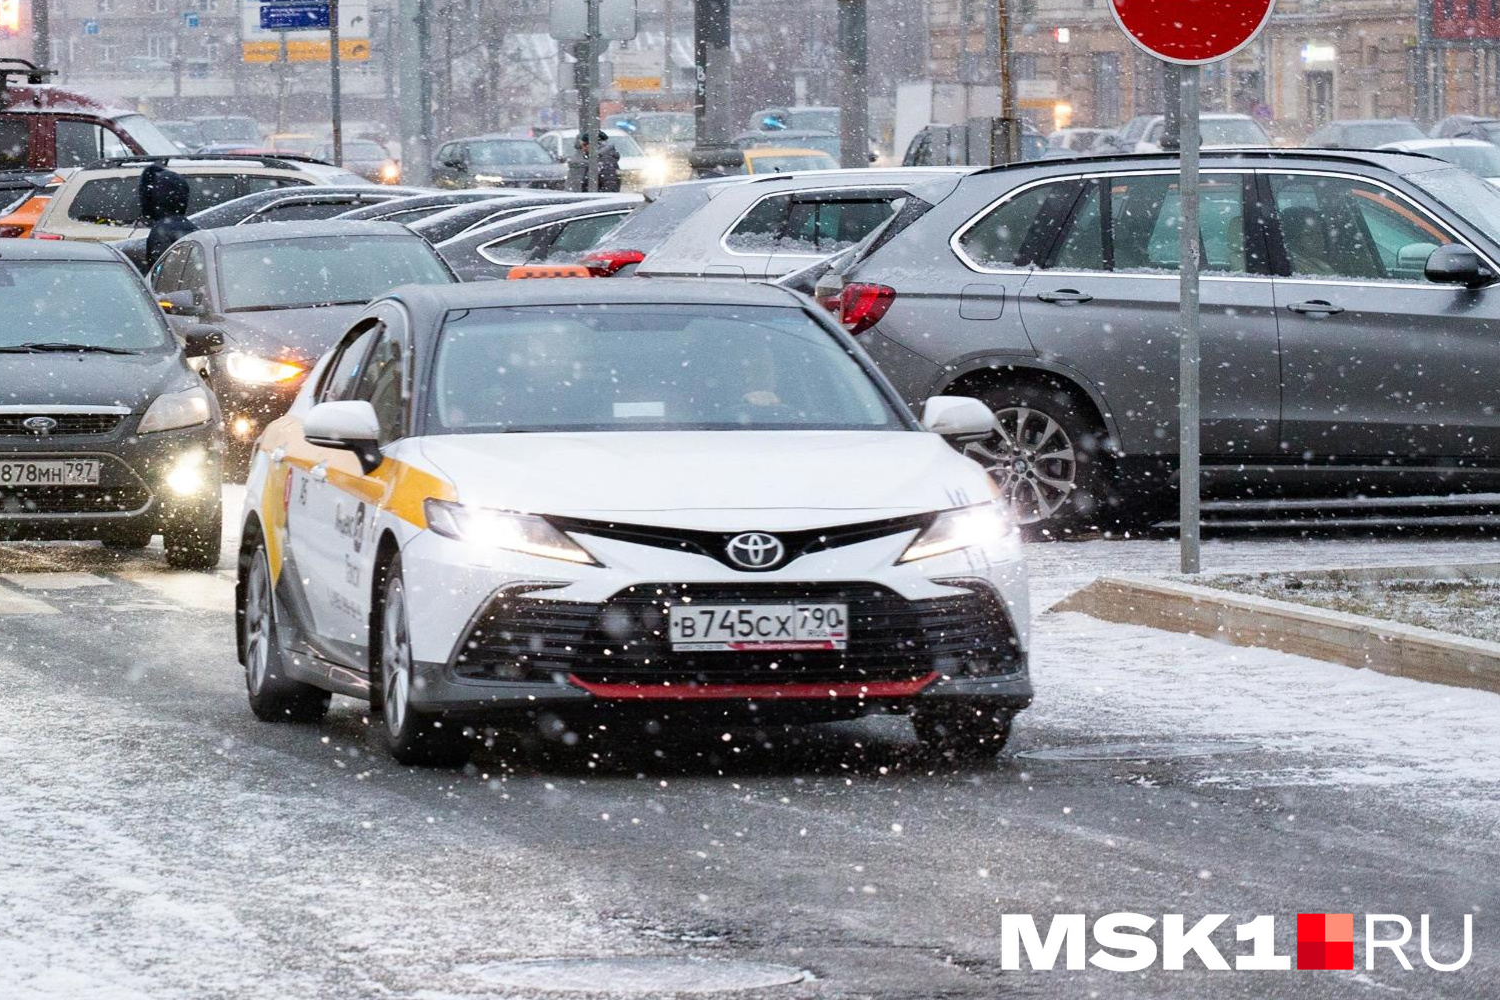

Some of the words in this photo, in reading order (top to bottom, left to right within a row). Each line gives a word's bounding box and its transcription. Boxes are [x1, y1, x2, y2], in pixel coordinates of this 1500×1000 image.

[65, 462, 93, 478] 797
[681, 610, 792, 638] В745СХ
[797, 608, 841, 629] 790
